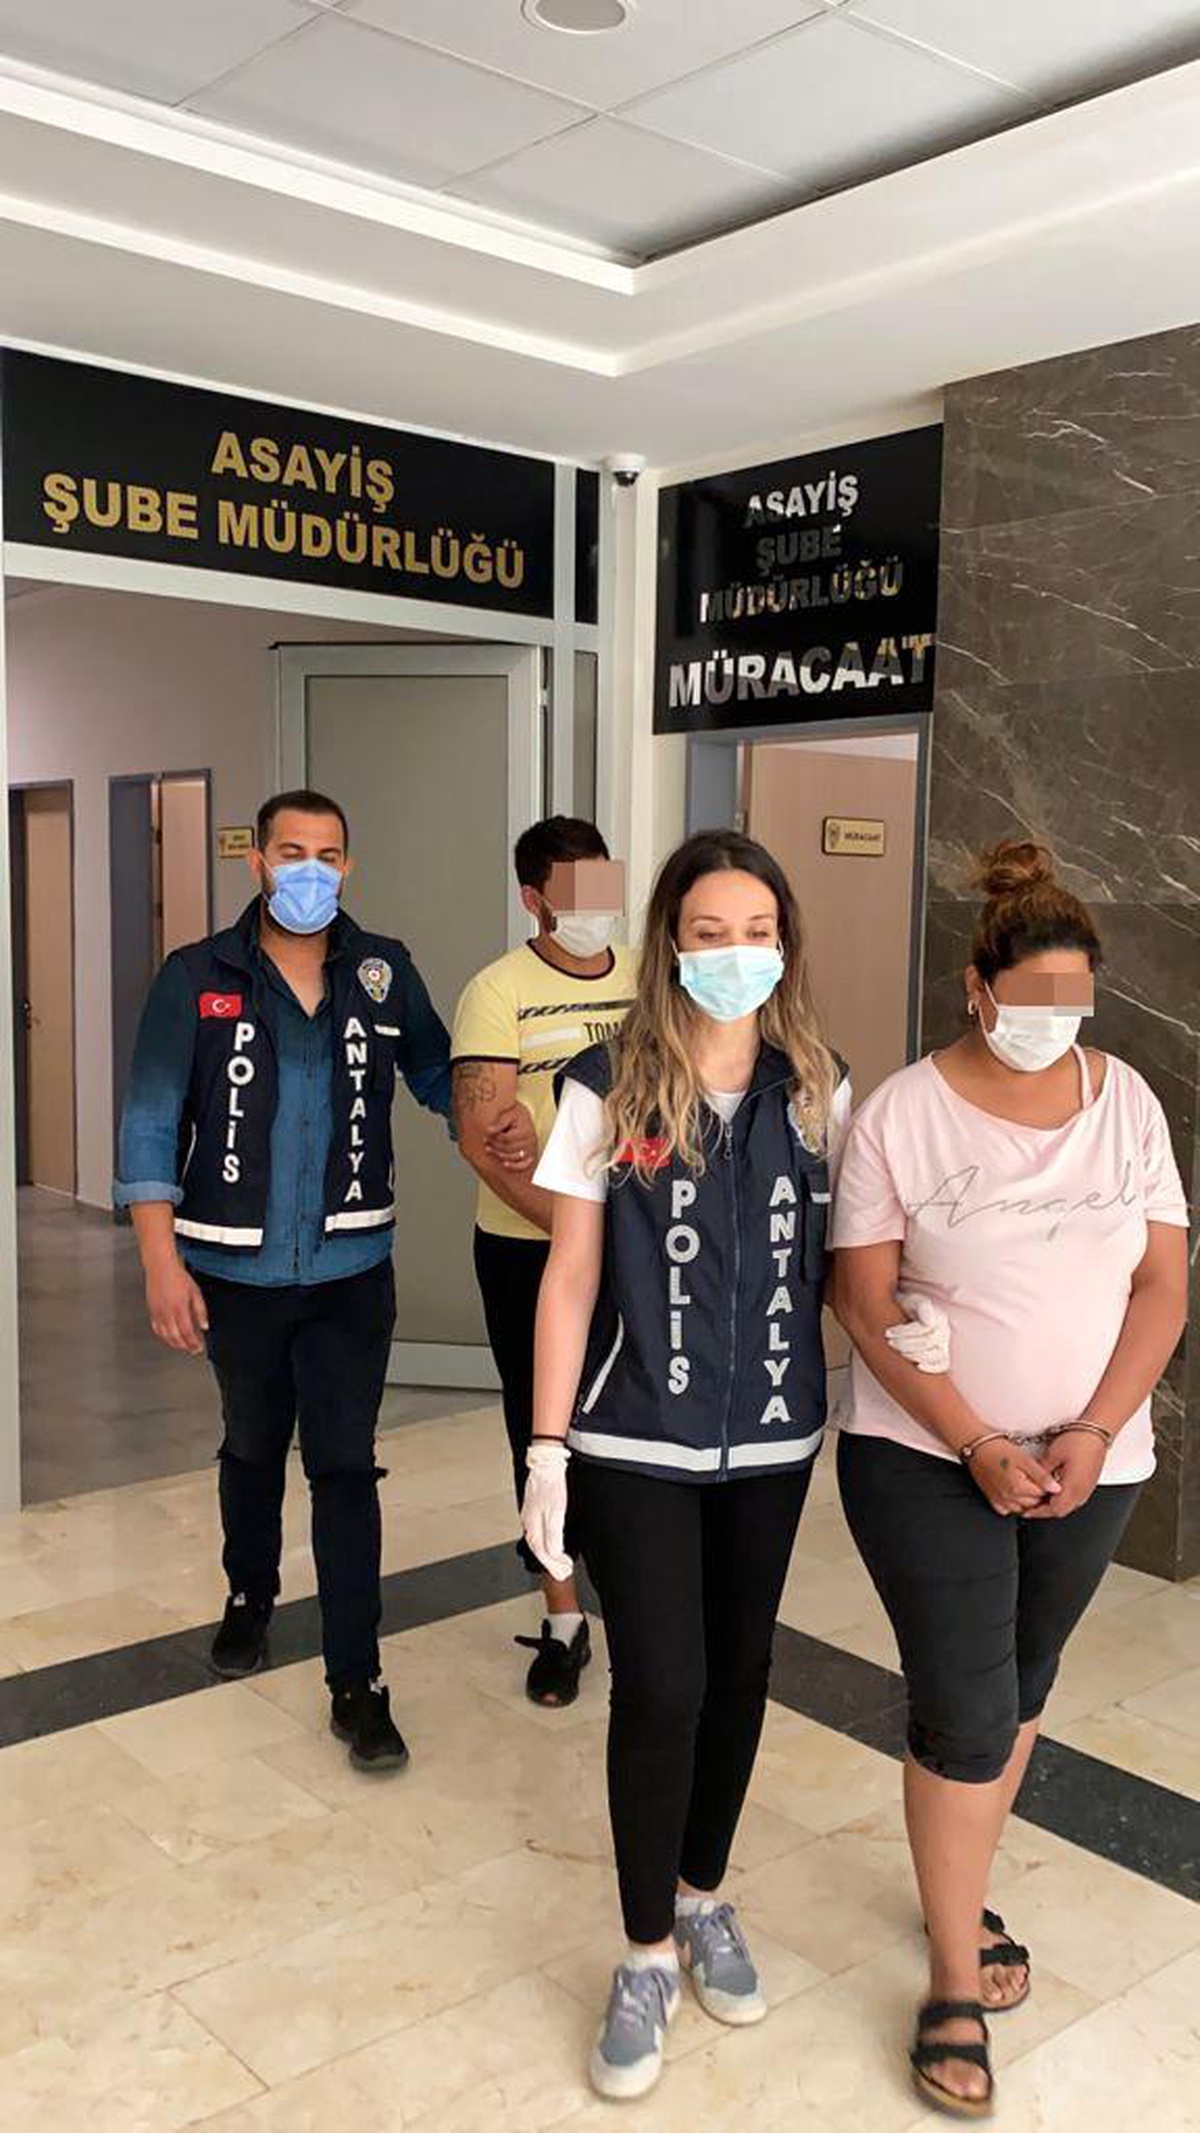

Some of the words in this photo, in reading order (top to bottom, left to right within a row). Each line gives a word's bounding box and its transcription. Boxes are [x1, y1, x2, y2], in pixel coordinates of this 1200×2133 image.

[211, 431, 395, 512] ASAYİŞ
[745, 470, 859, 527] ASAYİŞ
[42, 472, 200, 539] ŞUBE
[217, 499, 525, 589] MÜDÜRLÜĞÜ
[756, 524, 842, 576] ŞUBE
[700, 555, 903, 623] MÜDÜRLÜĞÜ
[668, 632, 934, 708] MÜRACAAT
[343, 1017, 367, 1203] ANTALYA
[907, 1160, 1137, 1241] Angel
[760, 1175, 797, 1424] ANTALYA
